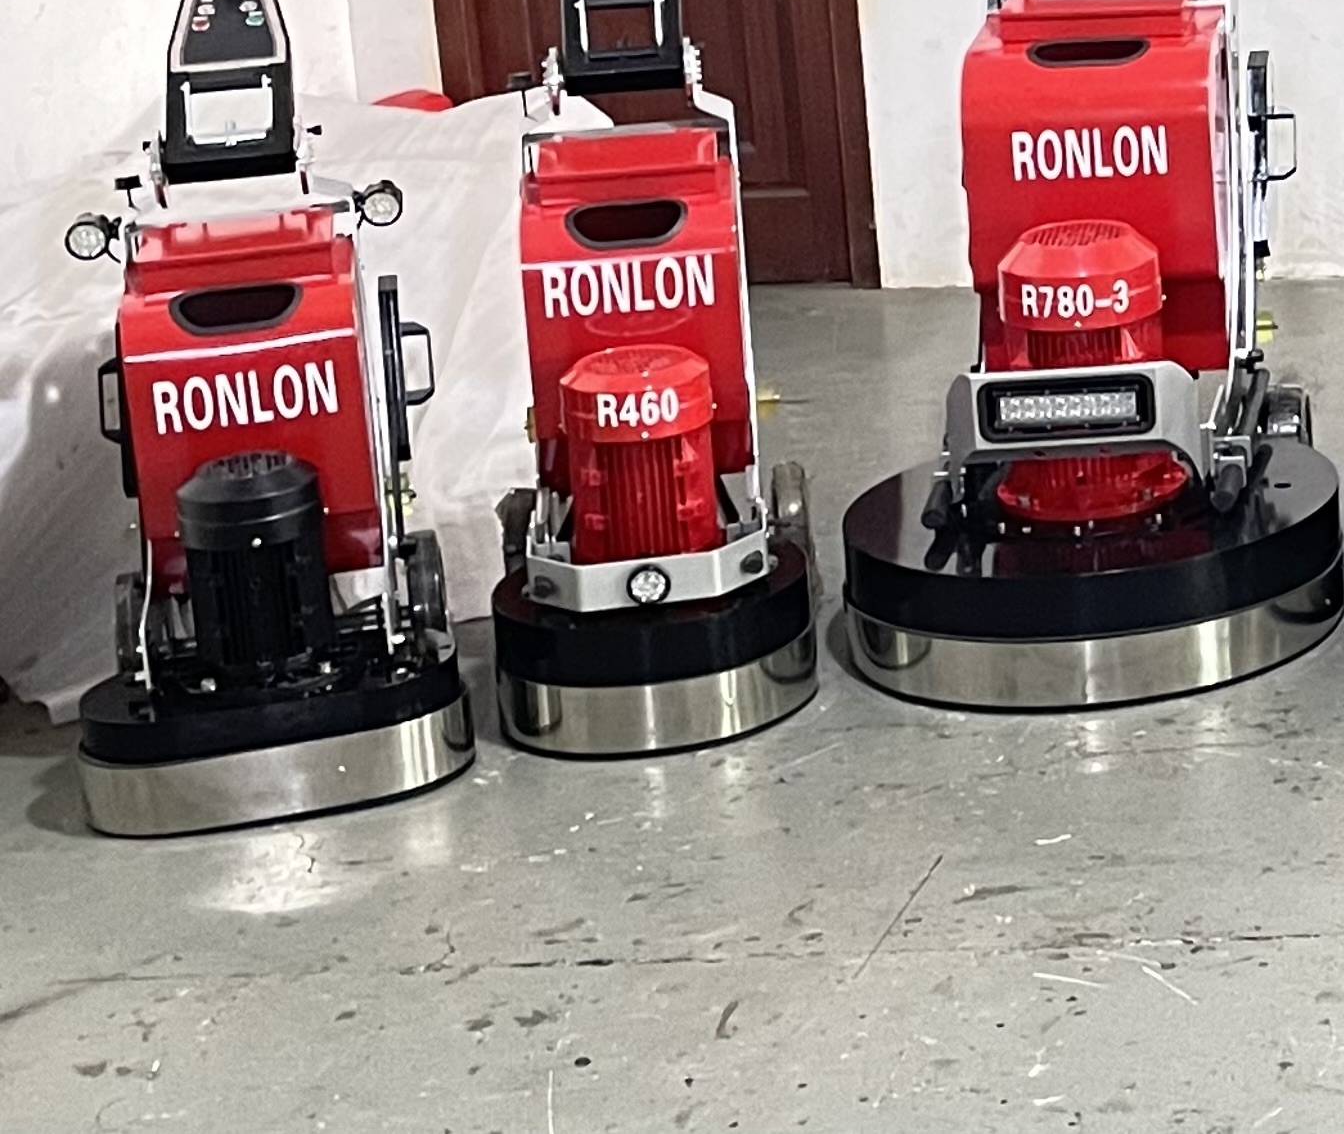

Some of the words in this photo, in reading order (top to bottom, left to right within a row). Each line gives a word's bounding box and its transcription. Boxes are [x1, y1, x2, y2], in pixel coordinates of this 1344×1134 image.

[1010, 125, 1168, 181] RONLON
[541, 252, 718, 319] RONLON
[1021, 279, 1132, 319] R780-3
[152, 359, 338, 435] RONLON
[596, 385, 680, 428] R460
